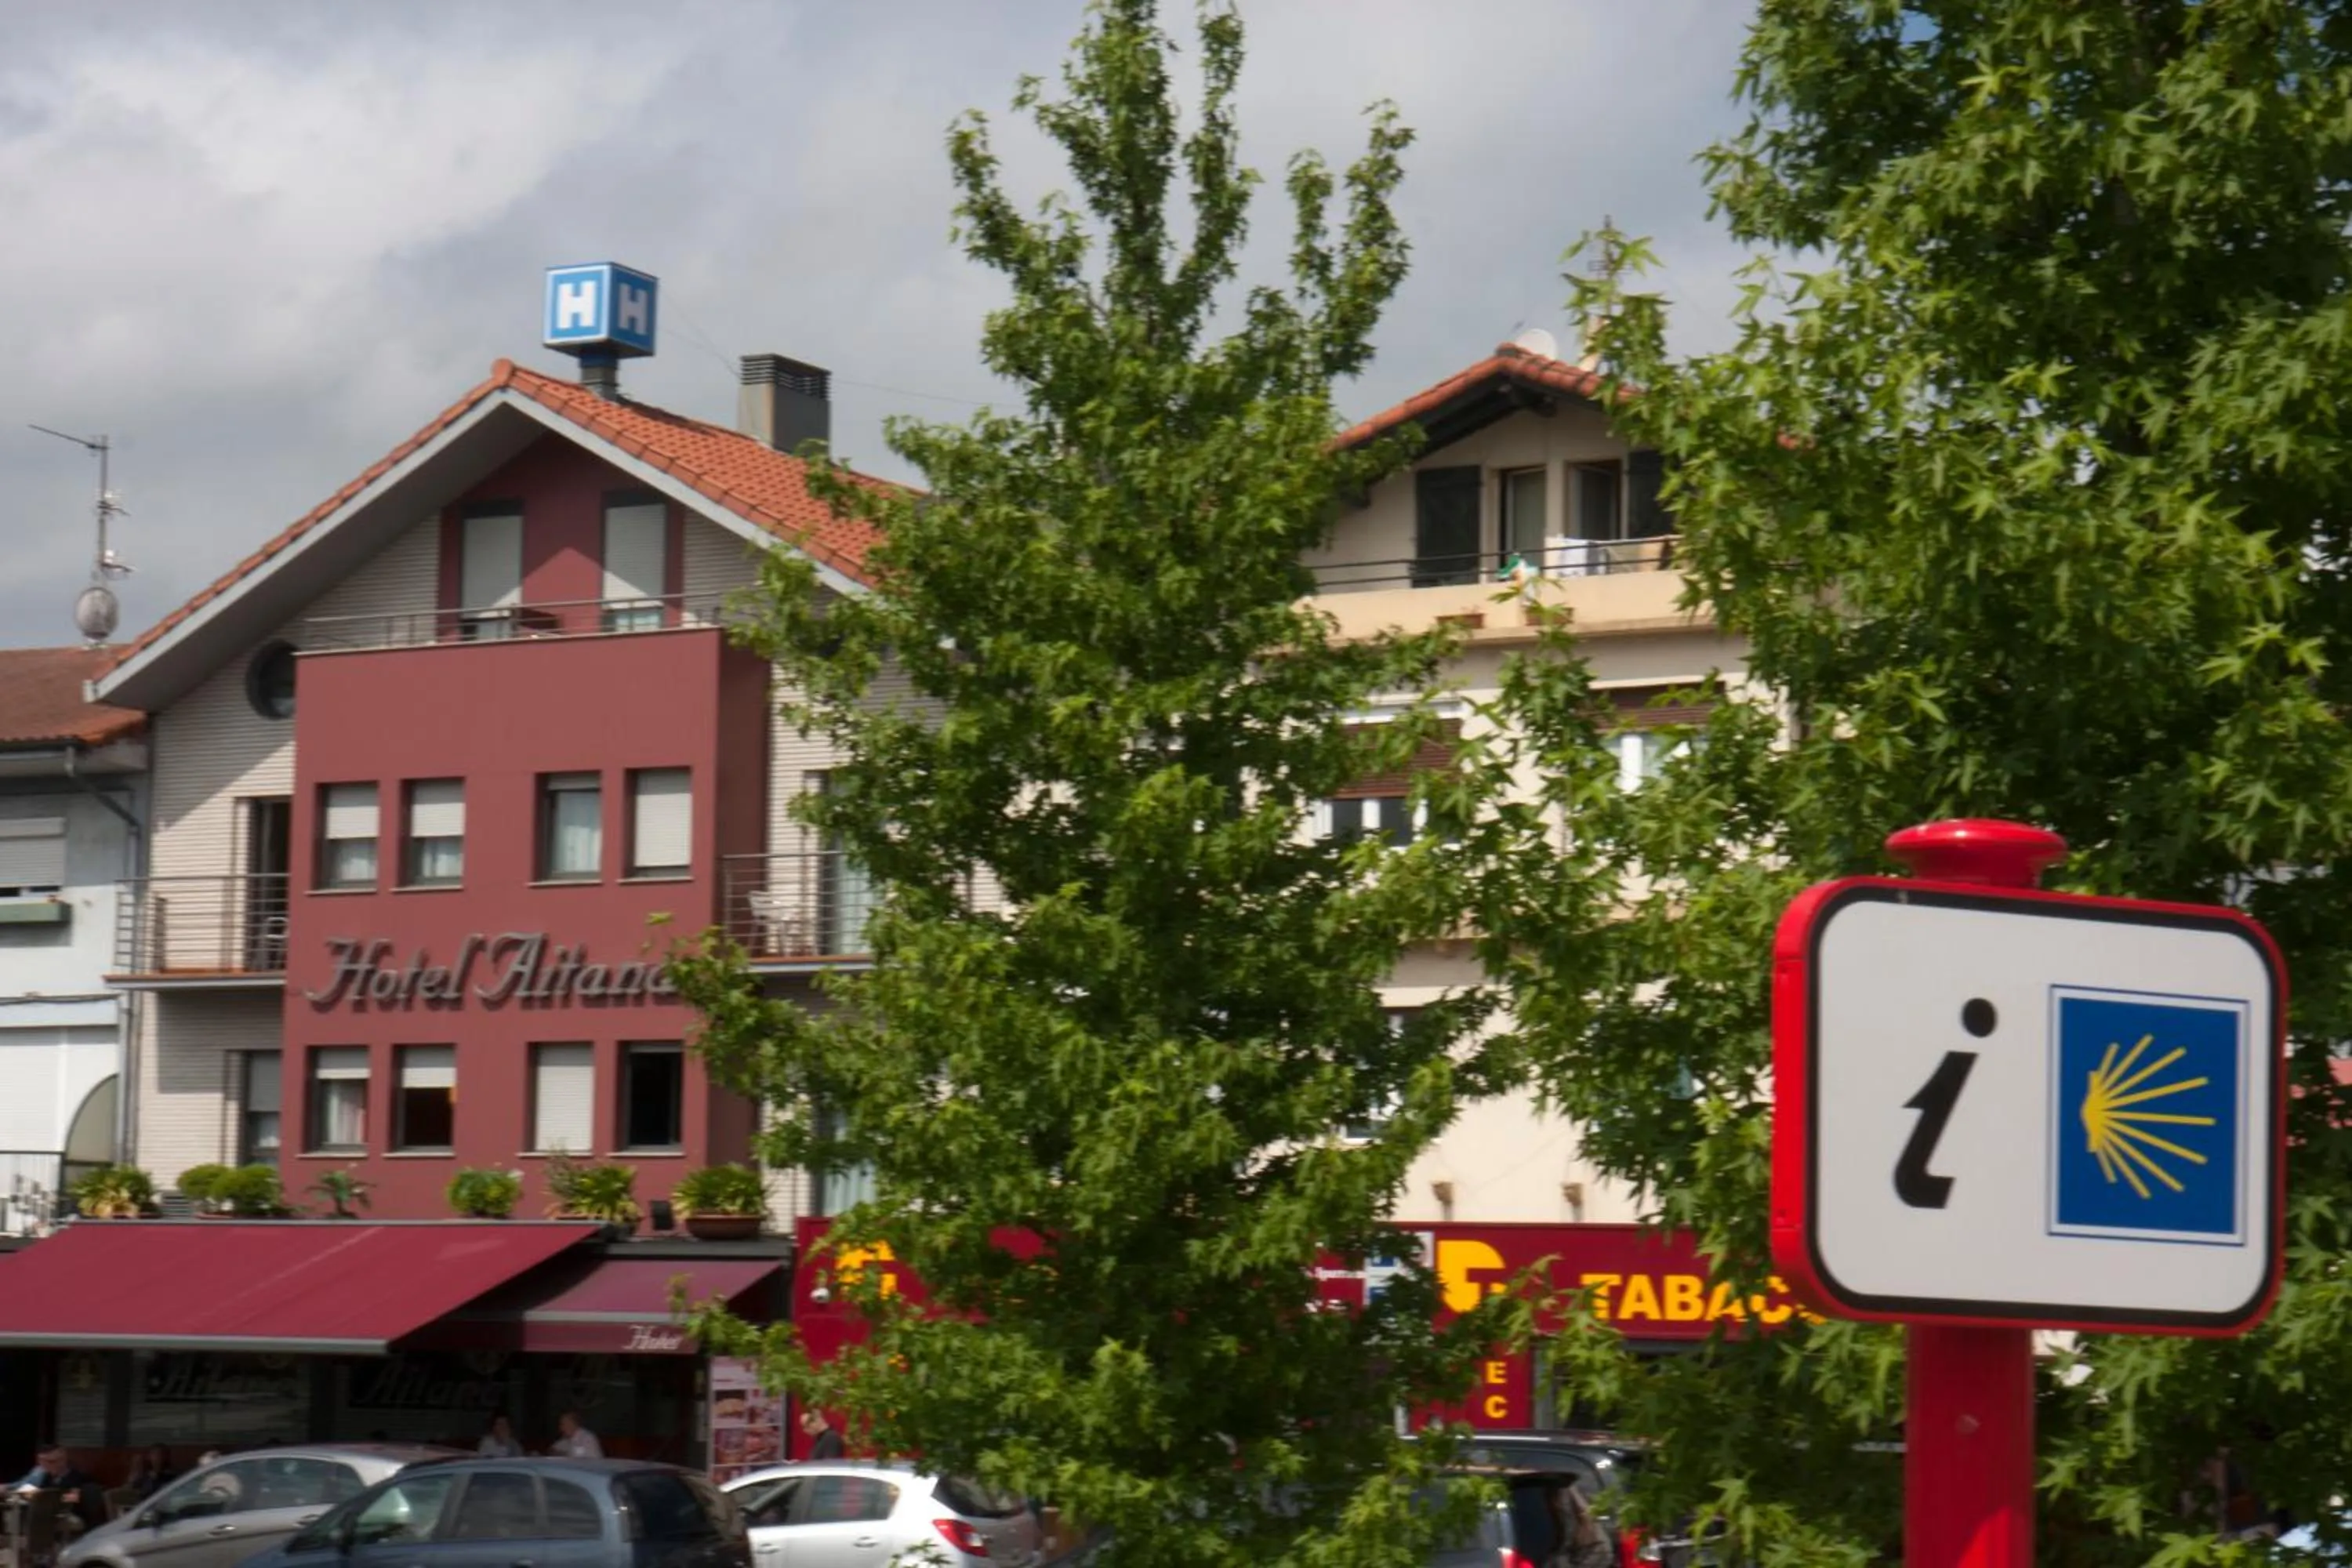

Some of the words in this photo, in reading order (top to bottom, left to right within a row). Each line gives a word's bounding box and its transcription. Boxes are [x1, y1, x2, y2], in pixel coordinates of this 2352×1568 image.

[557, 280, 597, 329] H
[617, 282, 649, 336] H
[303, 931, 486, 1004] Hotel
[1580, 1274, 1828, 1323] TABAC
